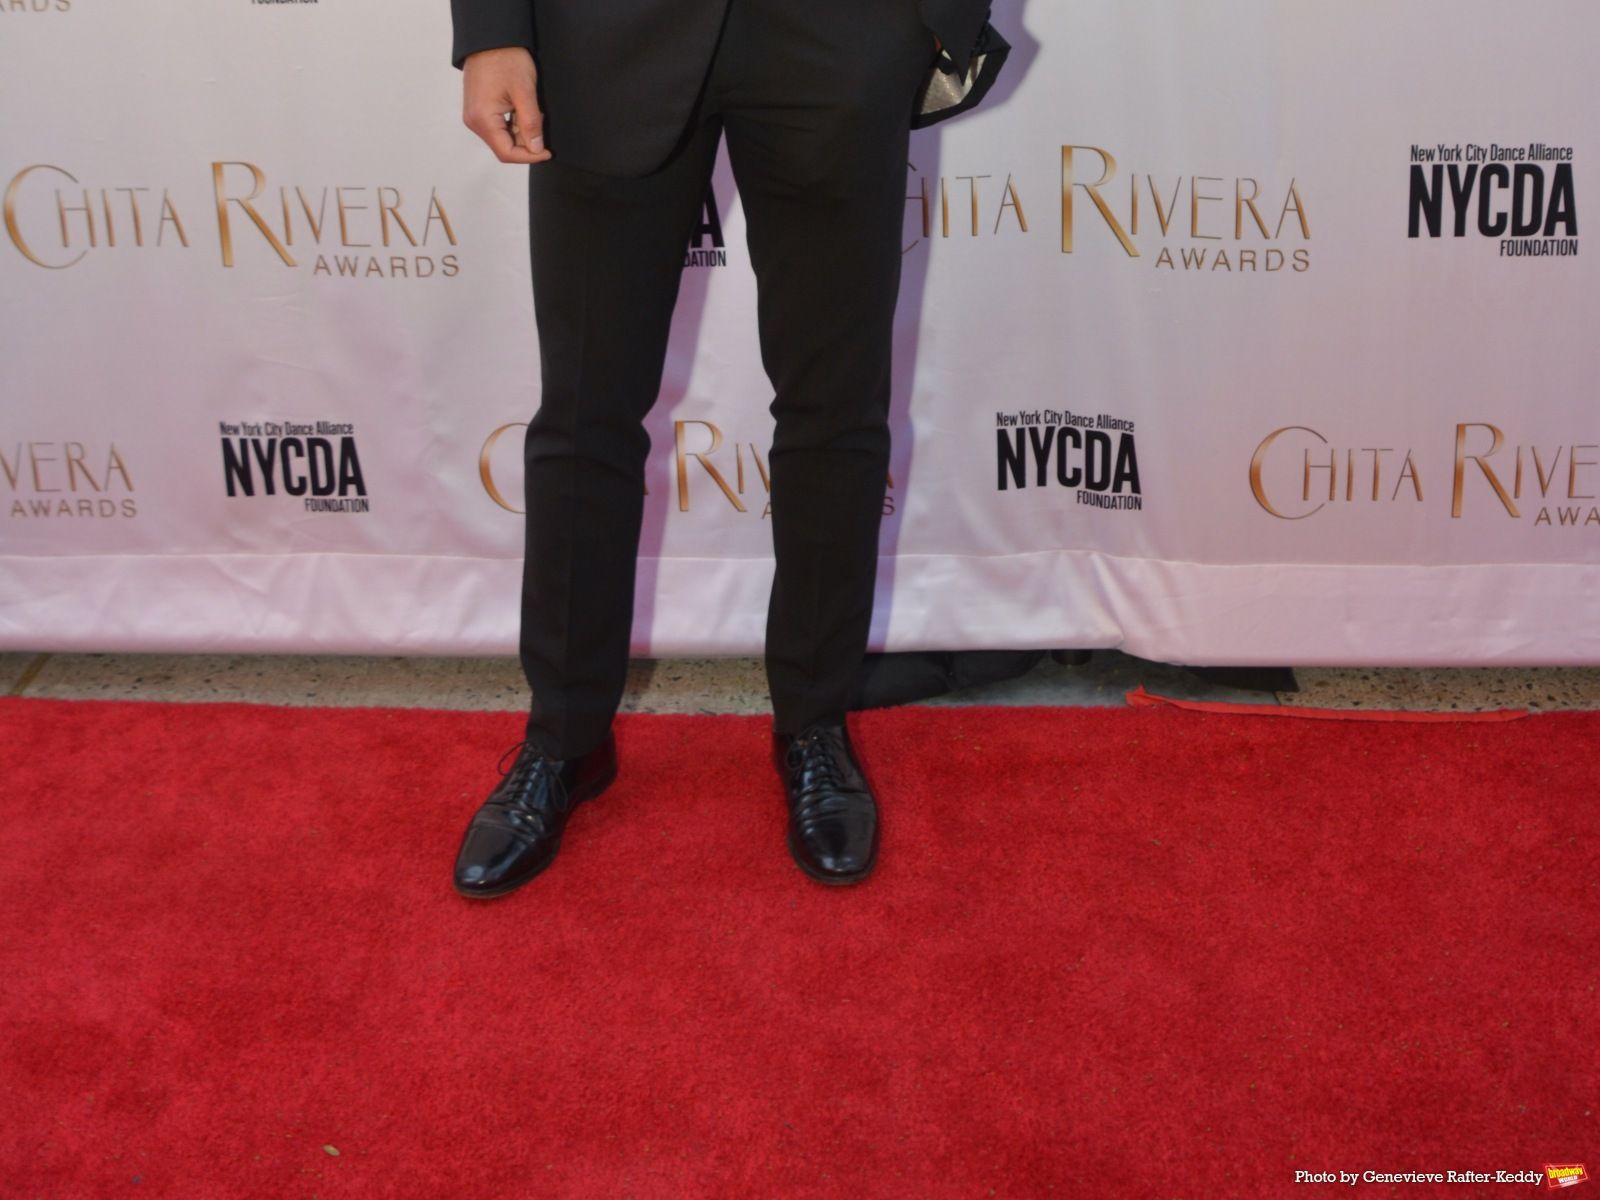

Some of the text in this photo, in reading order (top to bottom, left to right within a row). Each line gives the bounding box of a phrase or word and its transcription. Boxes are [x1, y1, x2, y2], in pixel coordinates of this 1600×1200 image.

[1410, 143, 1573, 163] New York City Dance Alliance
[1061, 144, 1311, 258] RIVERA
[1408, 163, 1578, 238] NYCDA
[3, 160, 458, 270] CHITA RIVERA
[1154, 247, 1311, 272] AWARDS
[1500, 239, 1578, 257] FOUNDATION
[313, 254, 460, 278] AWARDS
[219, 421, 353, 437] New York City Dance Alliance
[996, 409, 1135, 432] New York City Dance Alliance
[0, 441, 135, 493] VERA
[221, 436, 367, 497] NYCDA
[996, 426, 1141, 494] NYCDA
[1249, 423, 1600, 520] CHITA RIVE
[10, 498, 138, 519] AWARDS
[304, 498, 369, 513] FOUNDATION
[1077, 490, 1142, 511] FOUNDATION
